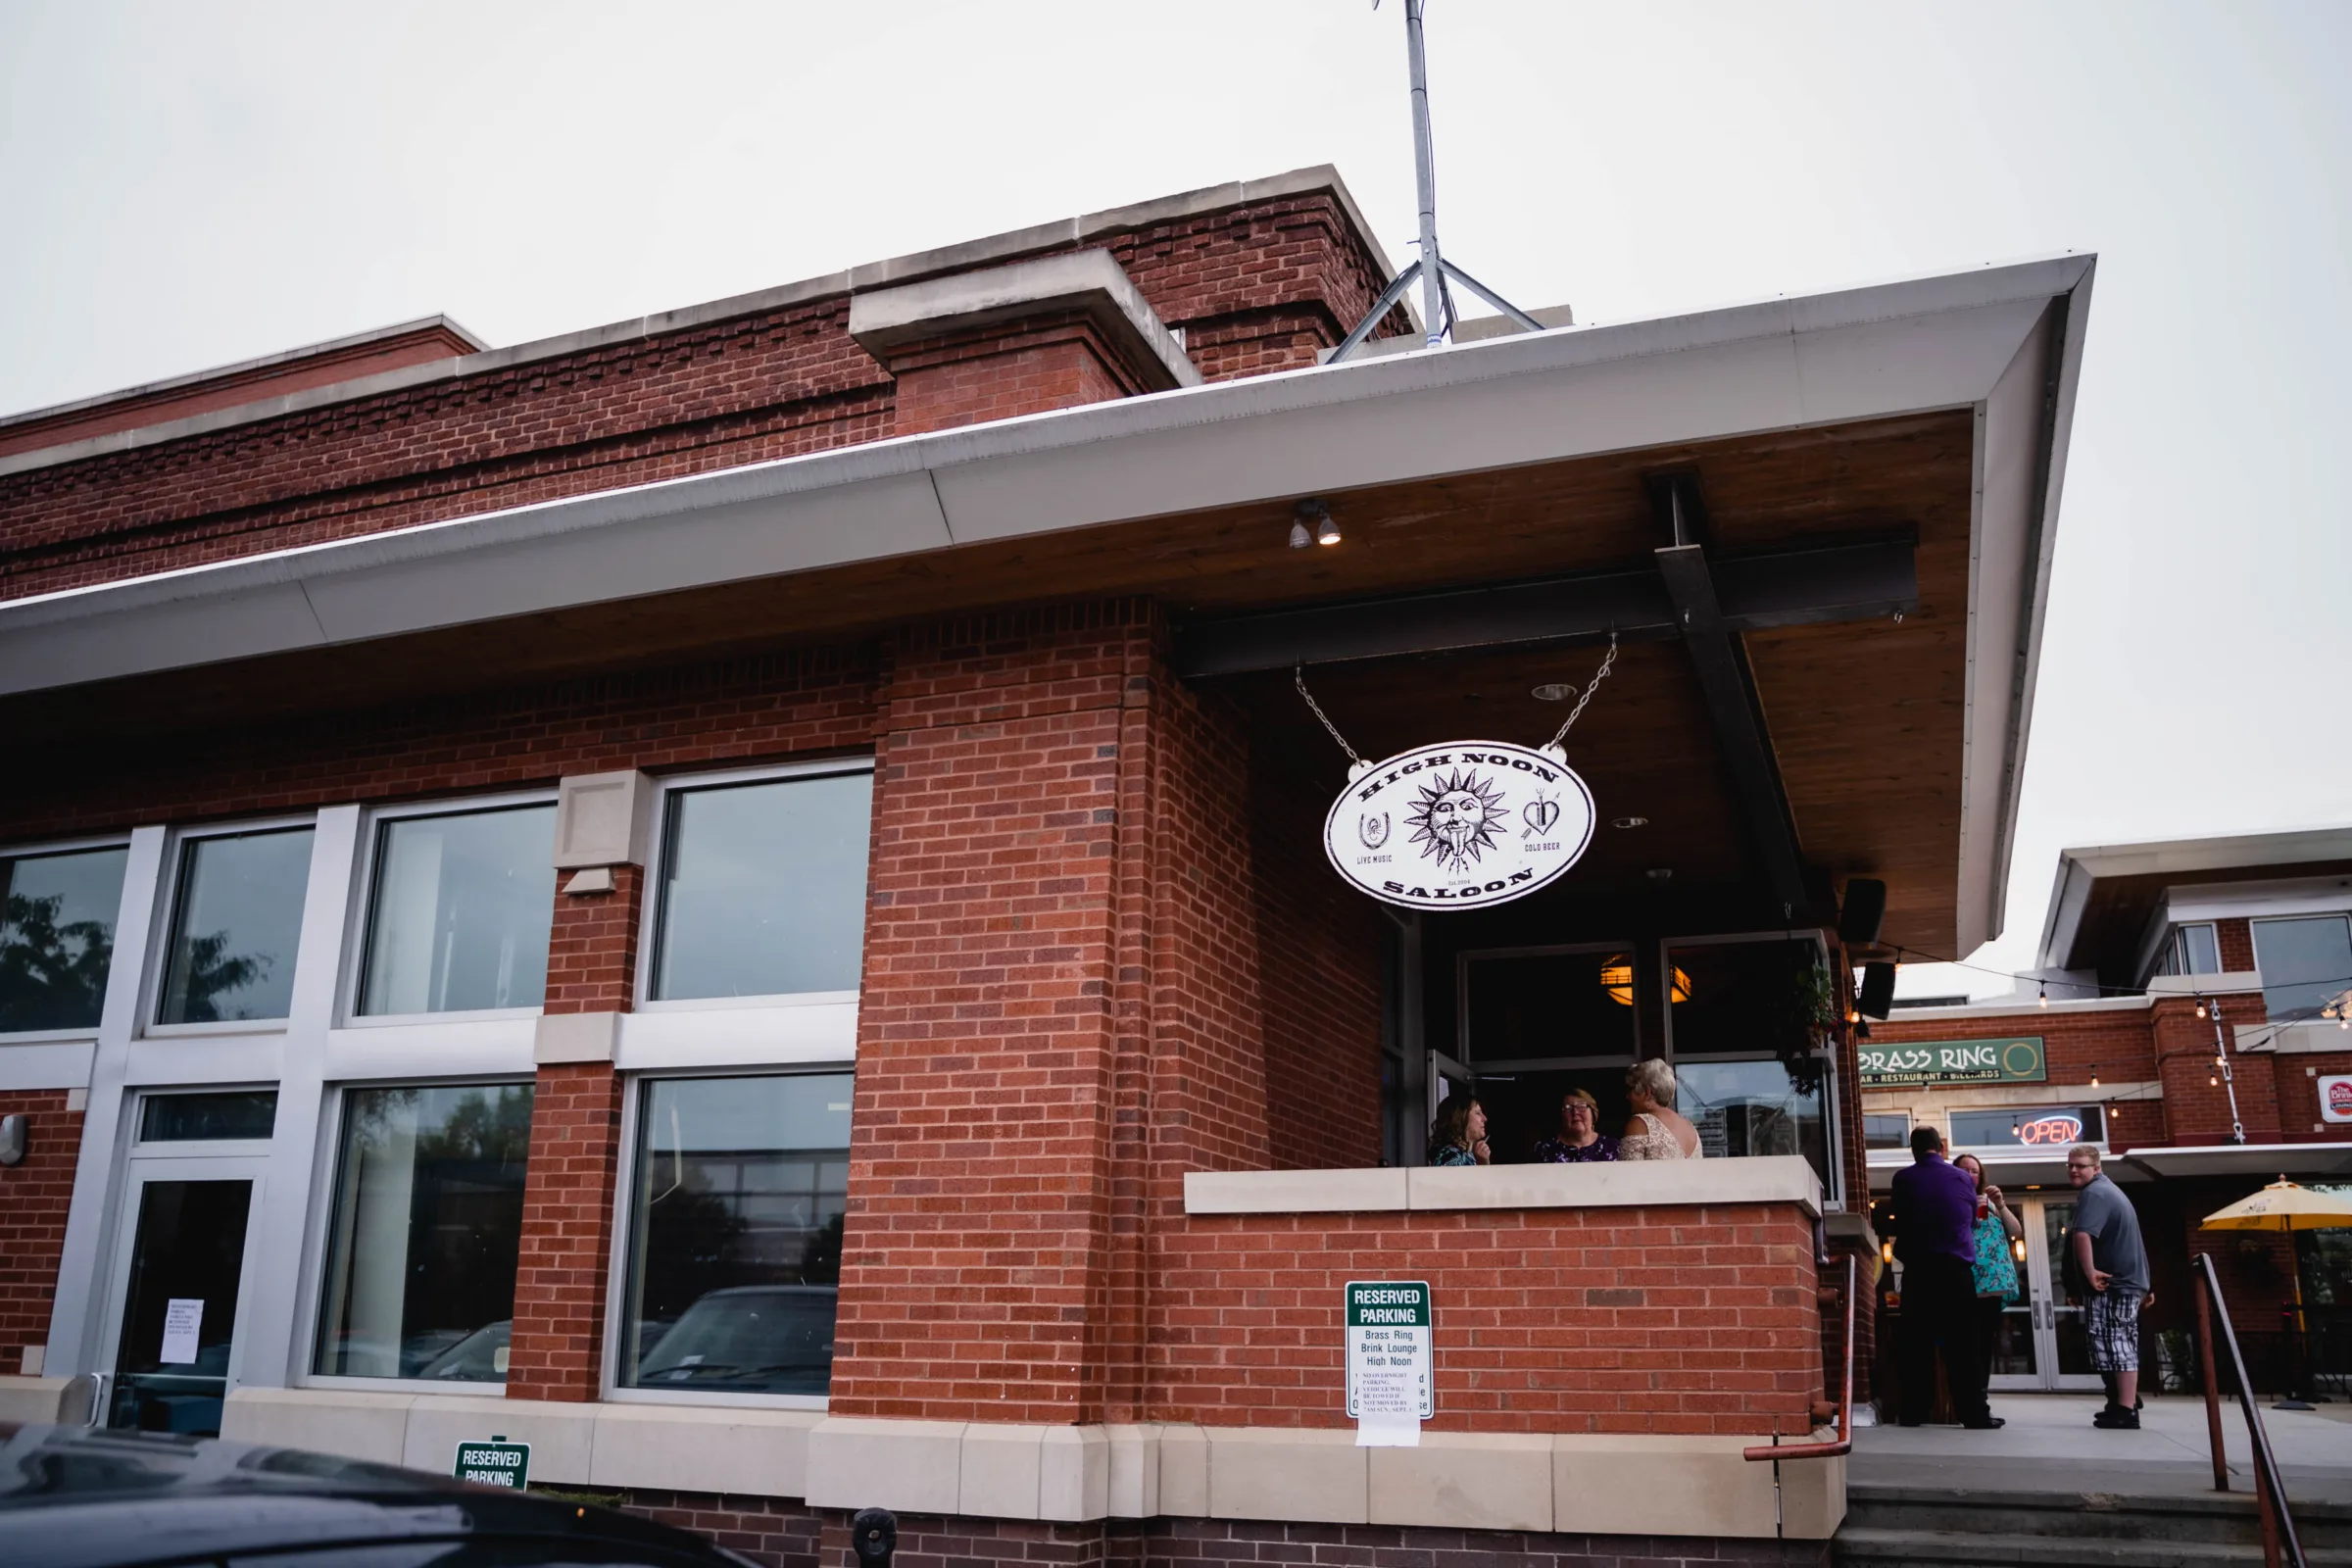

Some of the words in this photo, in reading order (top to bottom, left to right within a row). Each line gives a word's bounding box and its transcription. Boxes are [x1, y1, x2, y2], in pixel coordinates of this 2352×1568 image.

[1357, 754, 1452, 803] HIGH
[1461, 753, 1560, 784] NOON
[1543, 842, 1560, 851] BEER
[1356, 856, 1371, 864] LIVE
[1373, 855, 1393, 863] MUSIC
[1383, 867, 1534, 899] SALOON
[1939, 1046, 1997, 1069] RING
[1881, 1072, 1941, 1083] RESTAURANT
[2022, 1121, 2078, 1144] OPEN
[1354, 1290, 1420, 1304] RESERVED
[1360, 1308, 1416, 1323] PARKING
[1365, 1330, 1390, 1340] Brass
[1394, 1330, 1413, 1342] Ring
[1361, 1344, 1383, 1352] Brink
[1388, 1344, 1417, 1354] Lounge
[1366, 1356, 1386, 1366] High
[1391, 1356, 1412, 1366] Noon
[463, 1450, 521, 1467] RESERVED
[466, 1470, 514, 1487] PARKING
